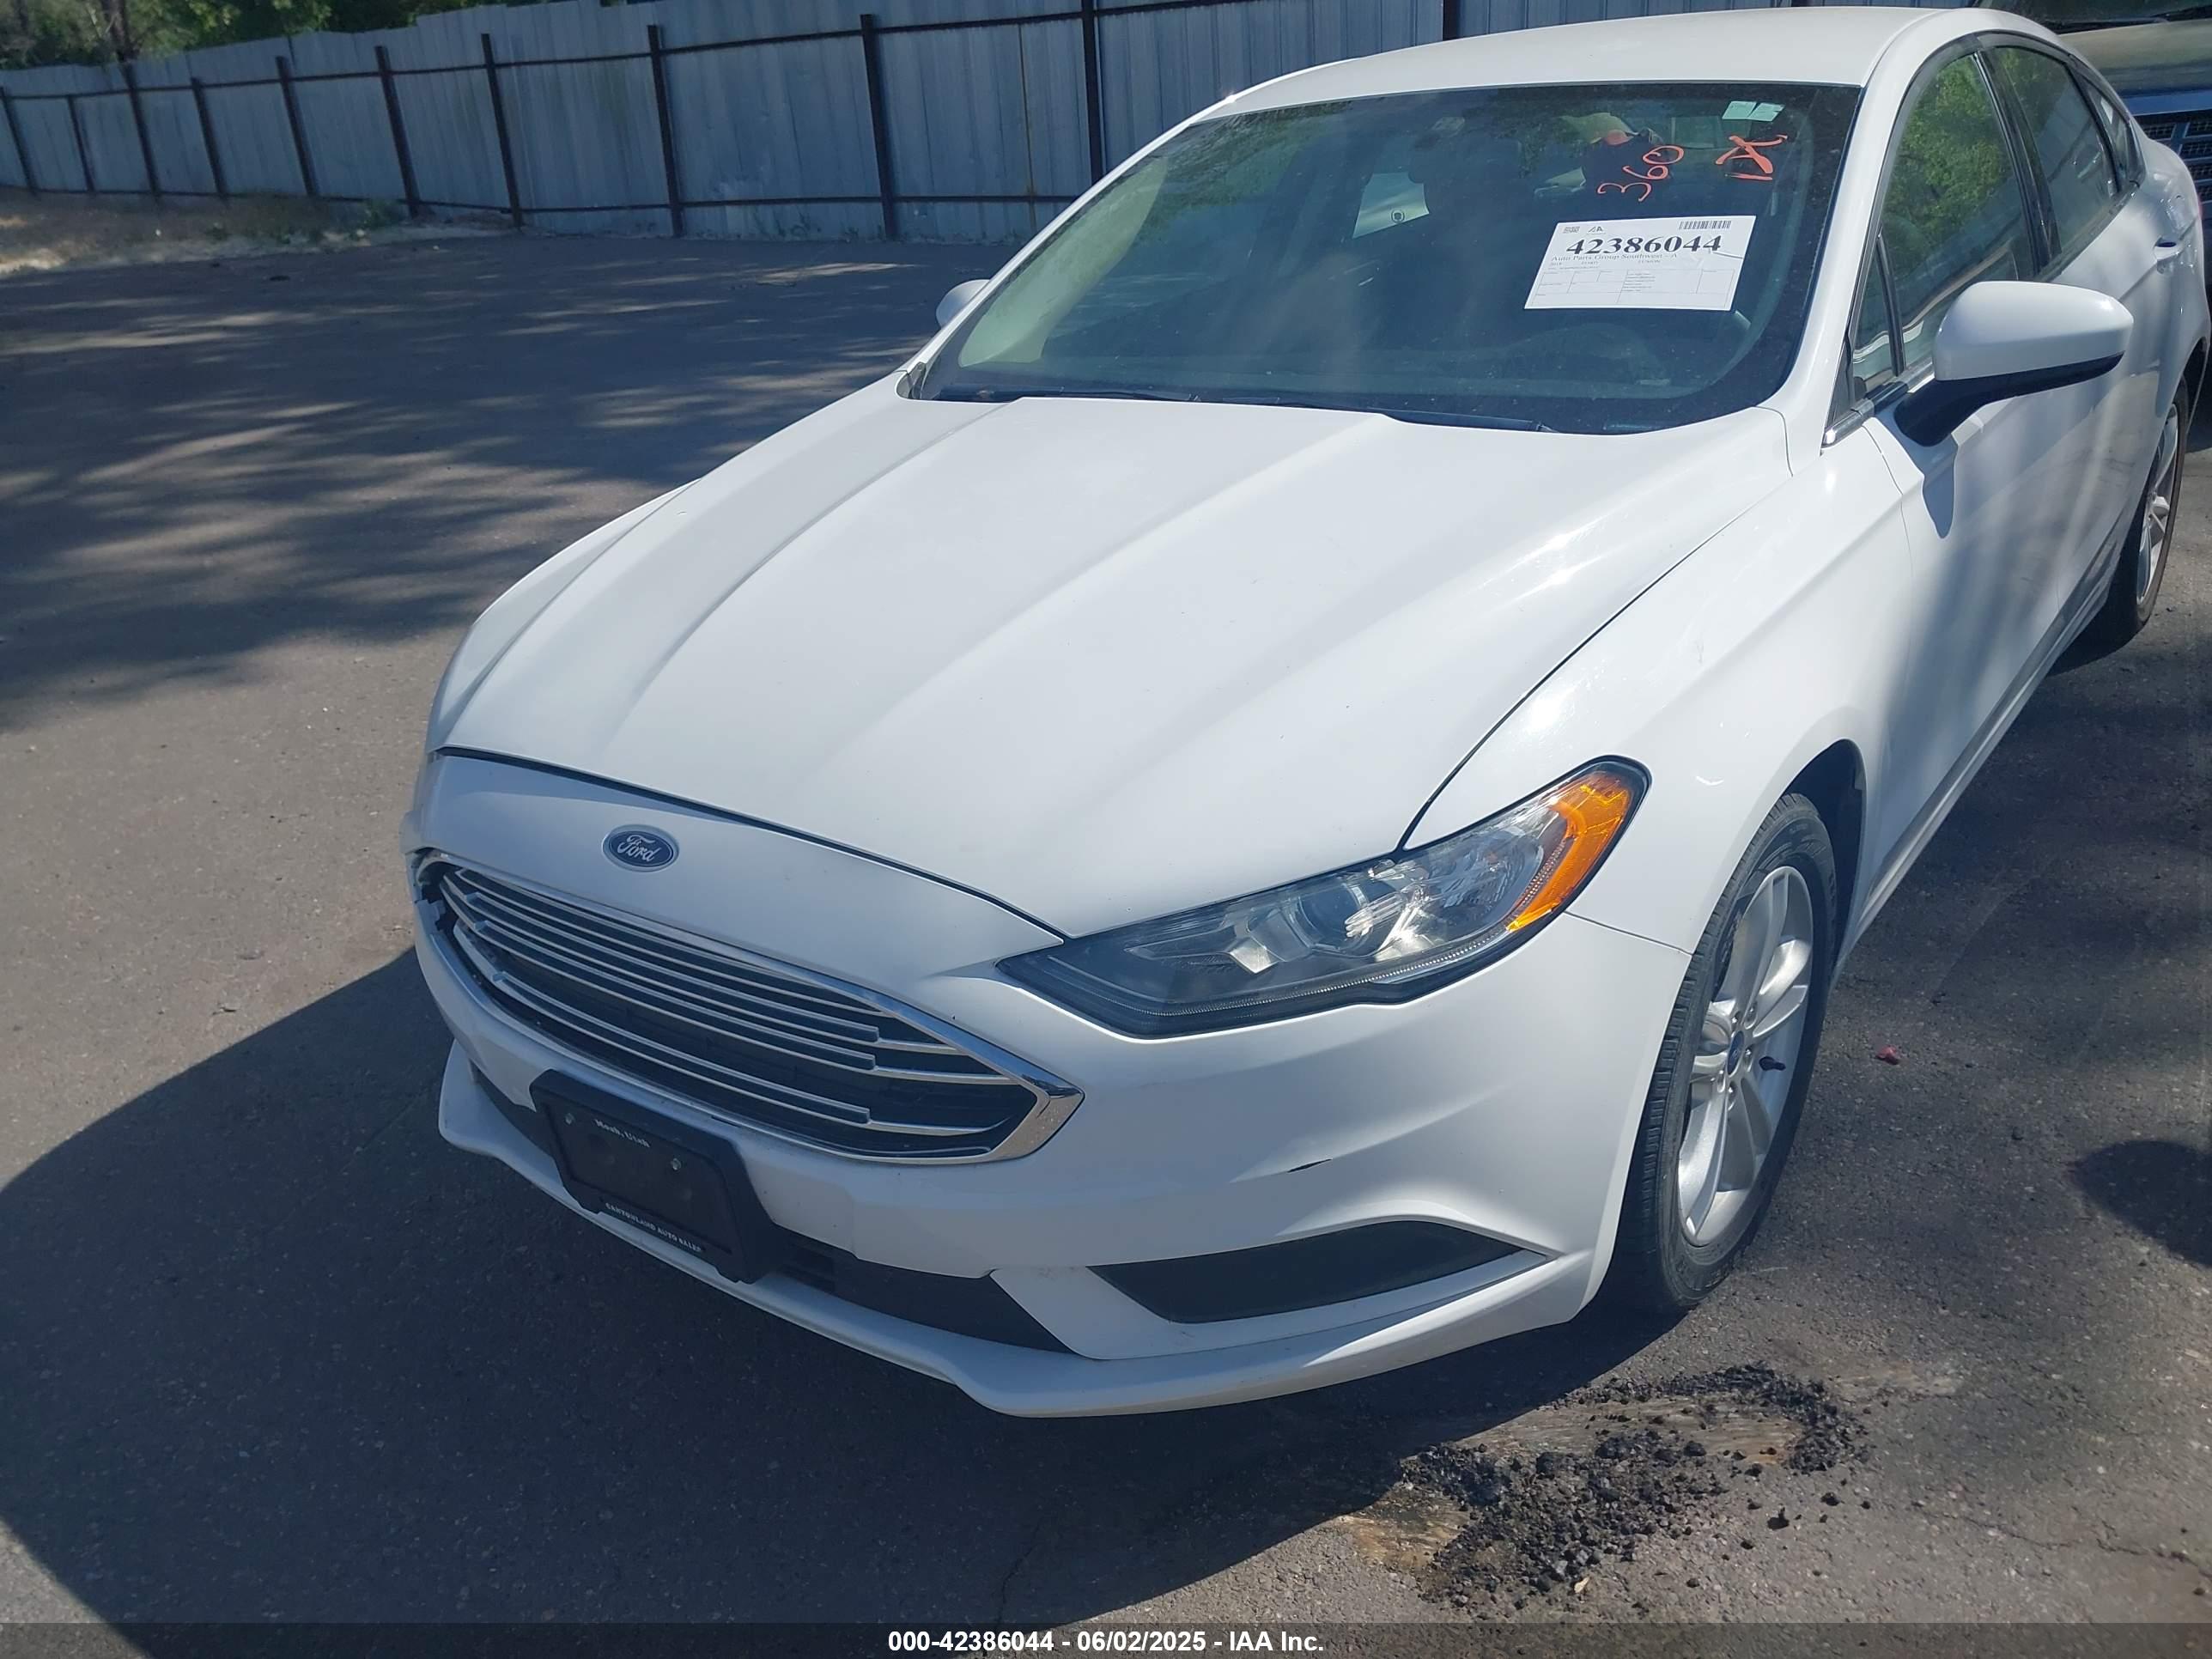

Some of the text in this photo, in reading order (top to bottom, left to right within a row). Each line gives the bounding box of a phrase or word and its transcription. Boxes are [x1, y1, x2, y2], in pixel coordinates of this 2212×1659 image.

[1597, 145, 1684, 202] 360
[1566, 235, 1722, 255] 42386044
[617, 834, 662, 862] Ford
[658, 1227, 678, 1242] AUTO
